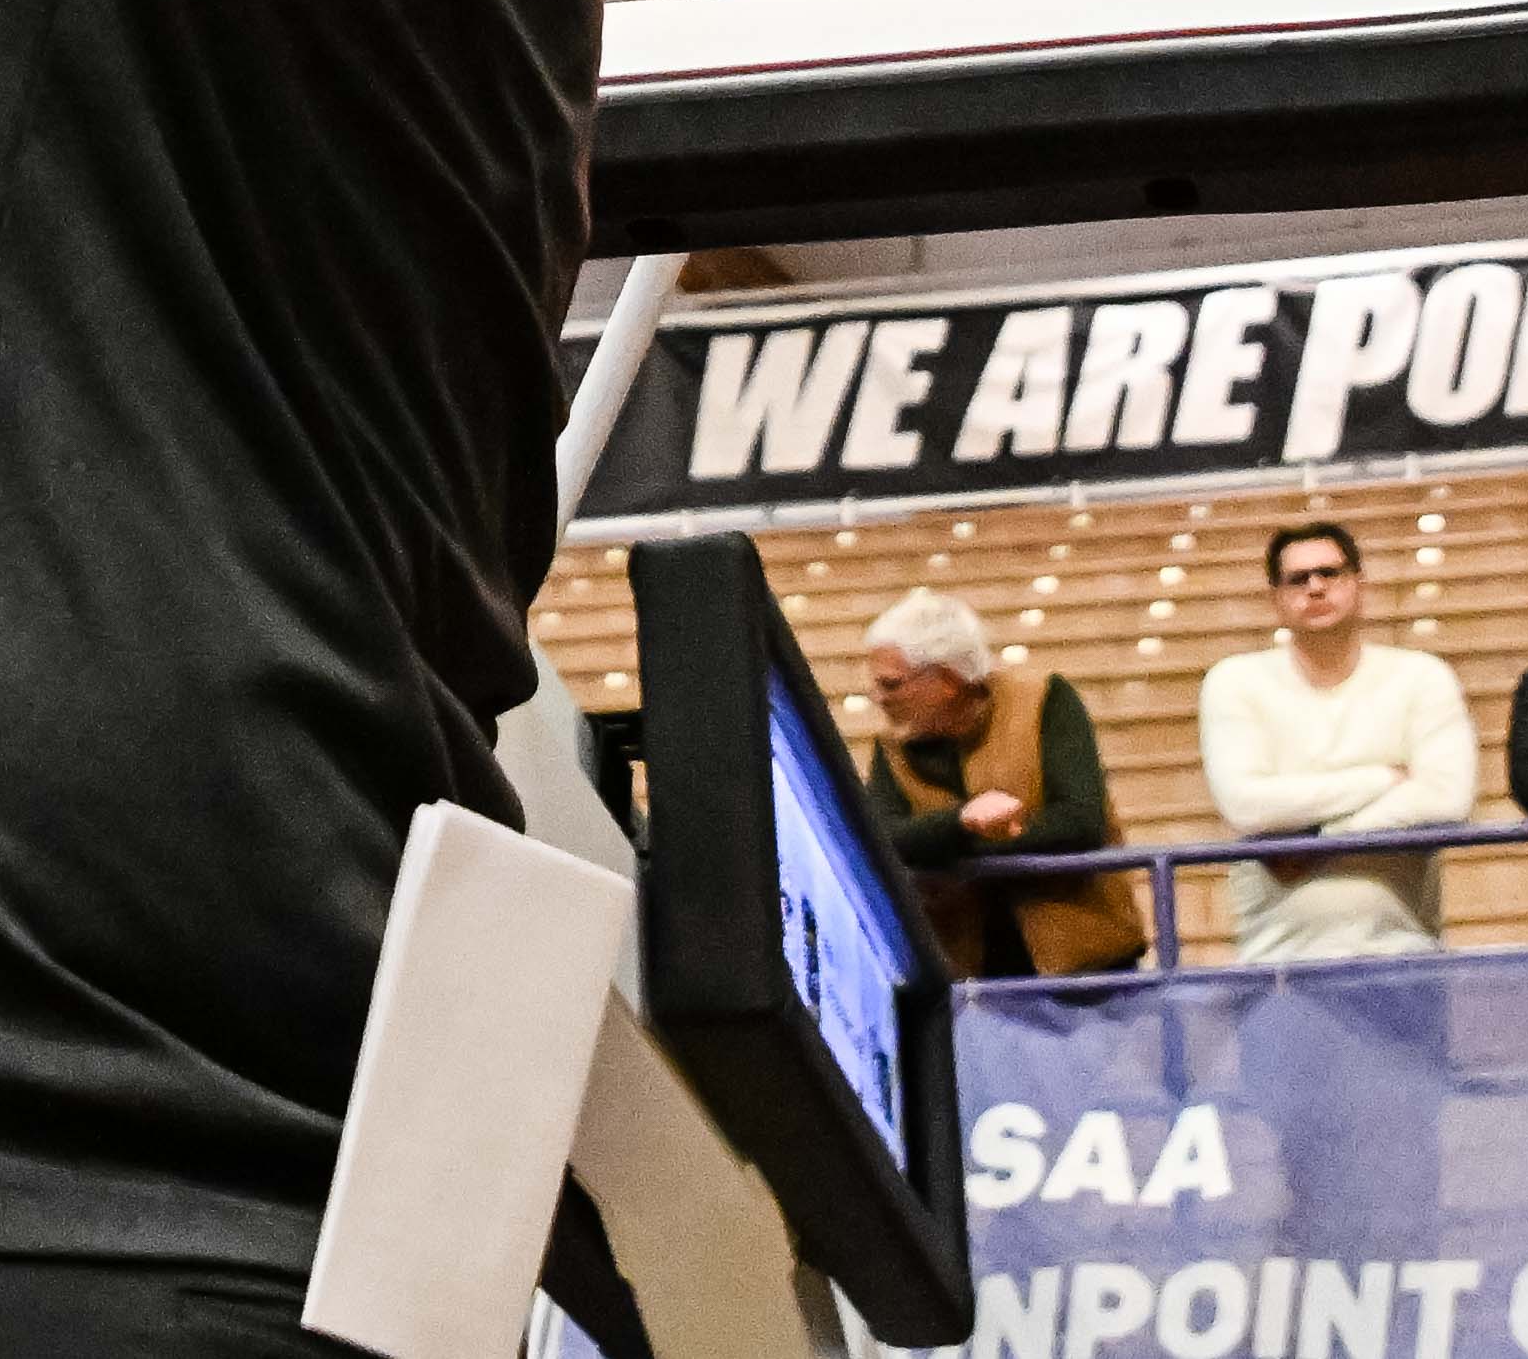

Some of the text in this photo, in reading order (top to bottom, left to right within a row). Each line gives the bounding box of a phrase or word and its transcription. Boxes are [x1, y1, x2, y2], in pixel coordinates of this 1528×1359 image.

[687, 316, 950, 482] WE
[948, 285, 1279, 464] ARE
[947, 1257, 1482, 1359] NPOINT
